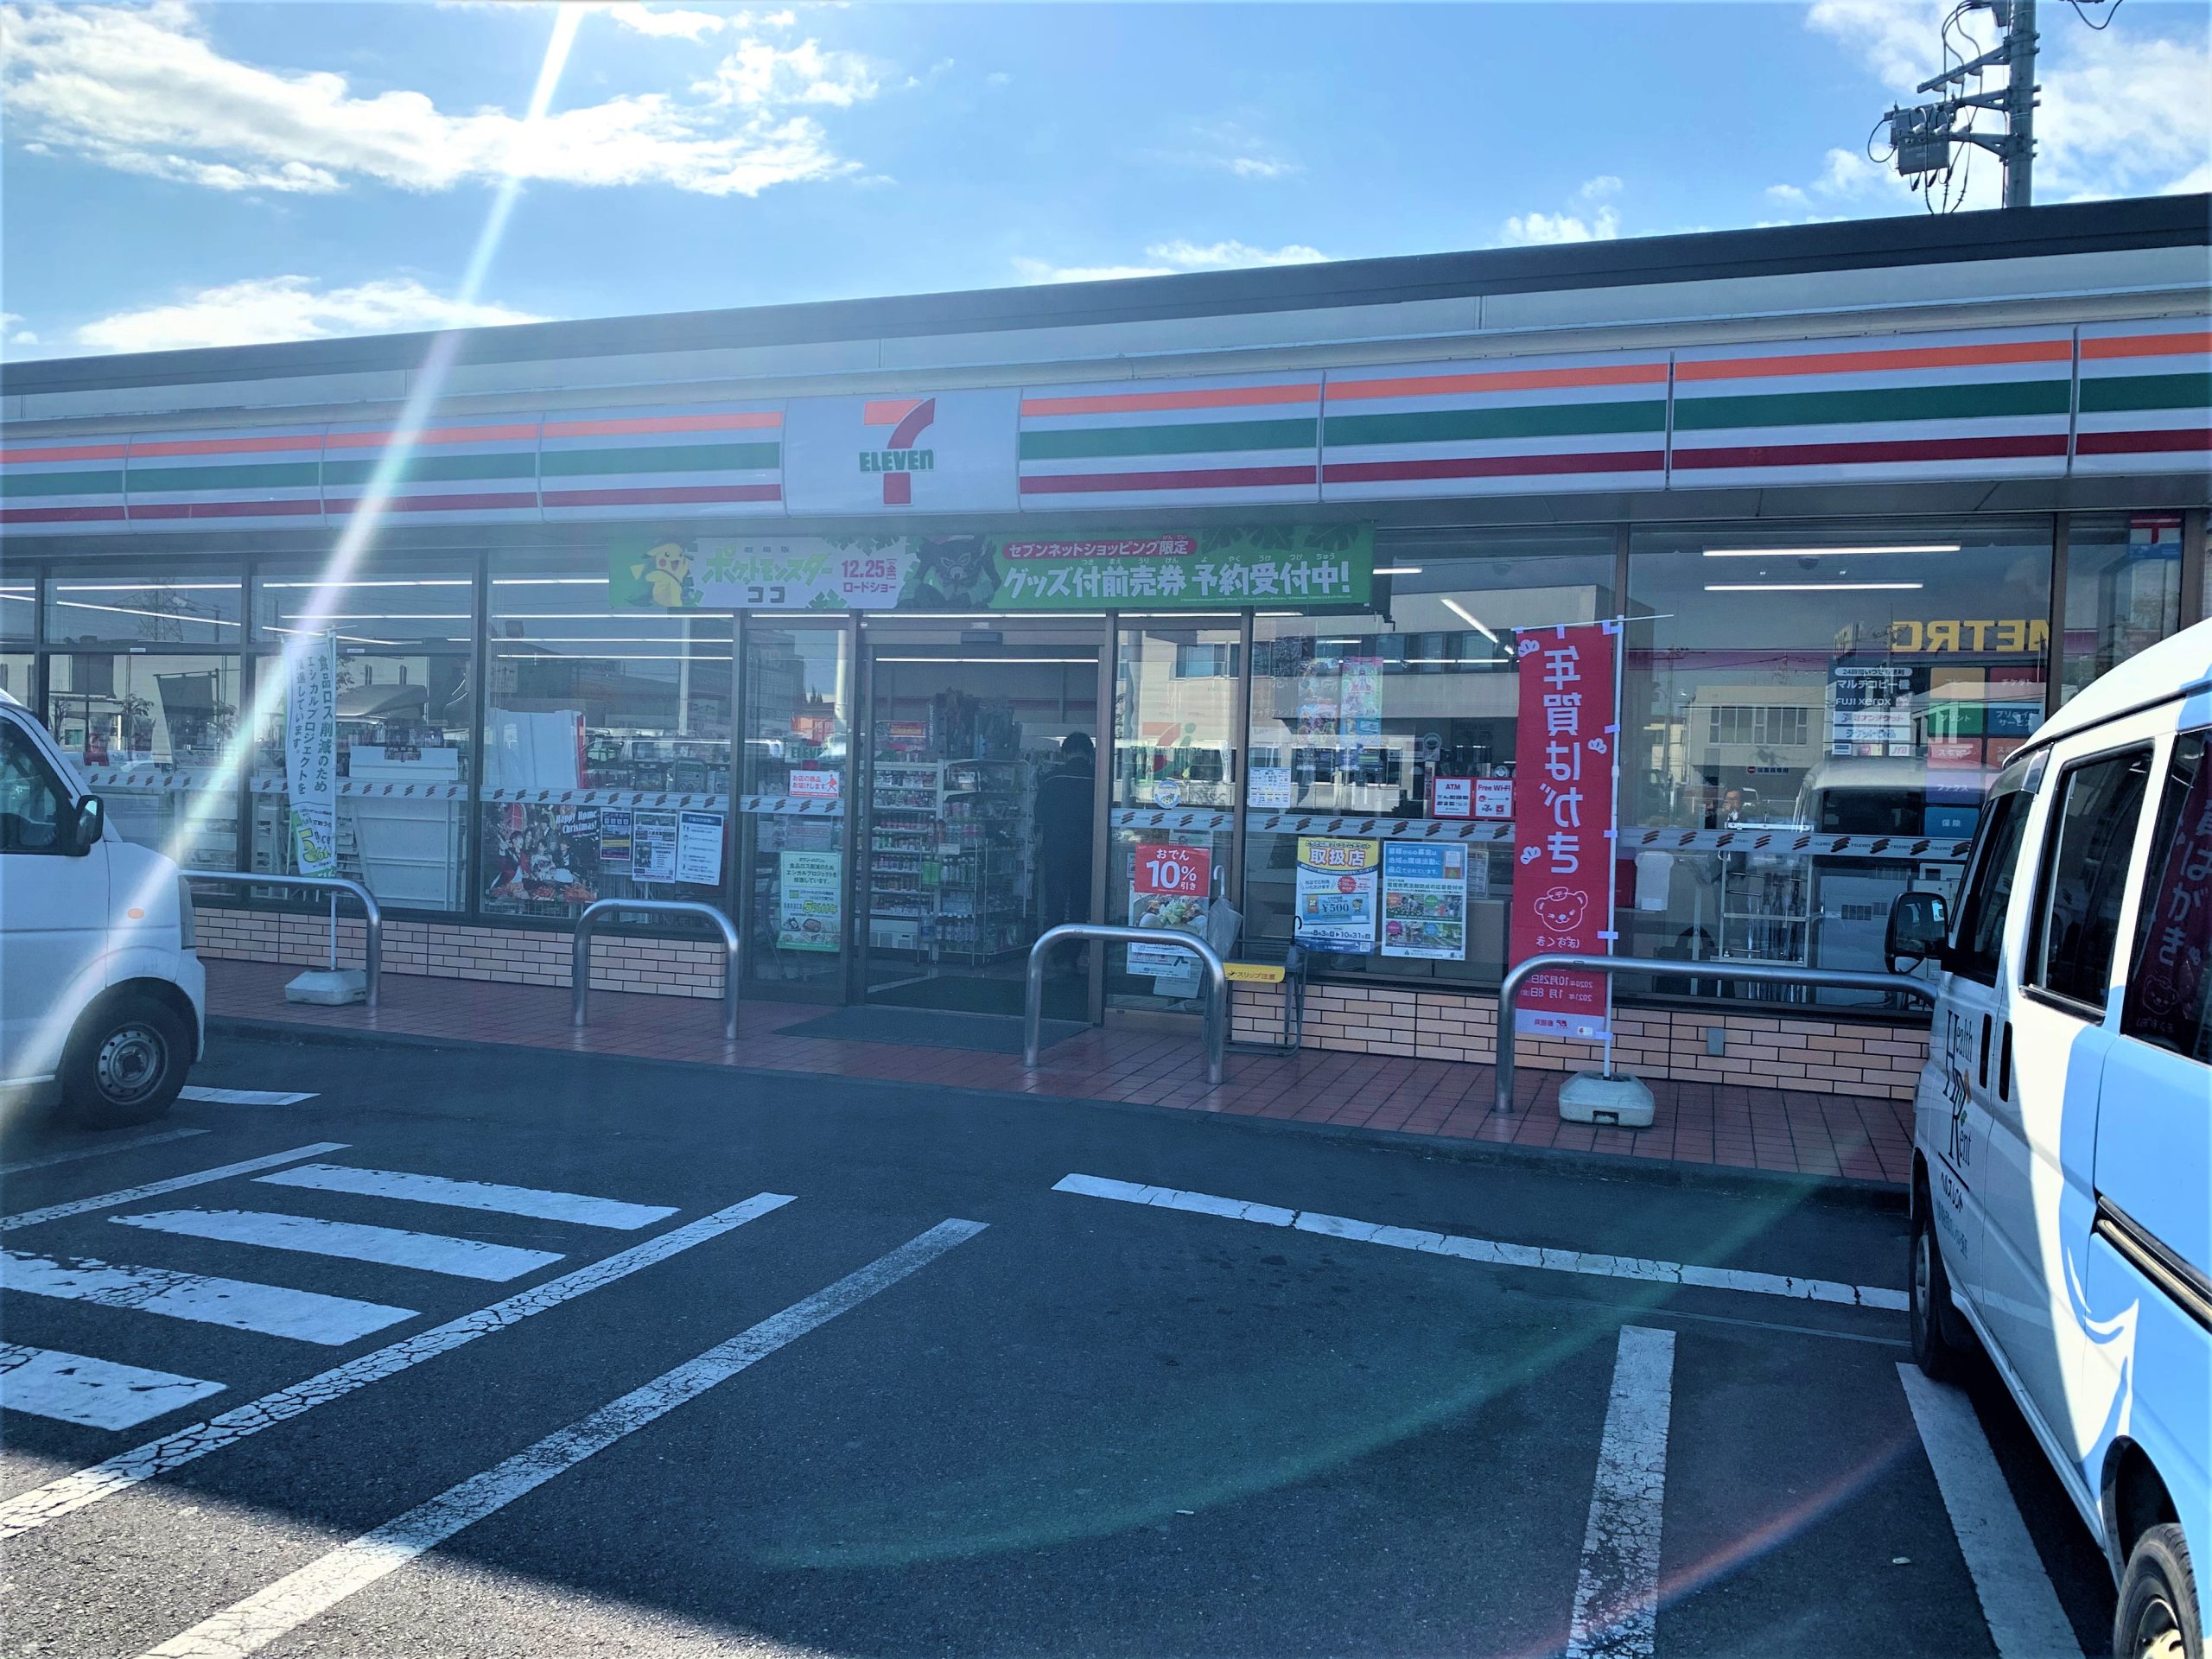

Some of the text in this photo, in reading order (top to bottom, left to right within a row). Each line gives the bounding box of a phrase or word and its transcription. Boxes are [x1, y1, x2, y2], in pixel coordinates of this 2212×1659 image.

[1008, 540, 1190, 558] セブンネットショッピング限定
[843, 582, 897, 593] ロードショー
[1003, 564, 1186, 600] グッズ付前売券
[747, 586, 785, 603] ココ
[1157, 849, 1189, 861] おでん
[1310, 849, 1366, 867] 取扱店
[1147, 861, 1197, 888] 10%
[1181, 881, 1197, 890] 引き
[1236, 971, 1276, 981] スリップ注意
